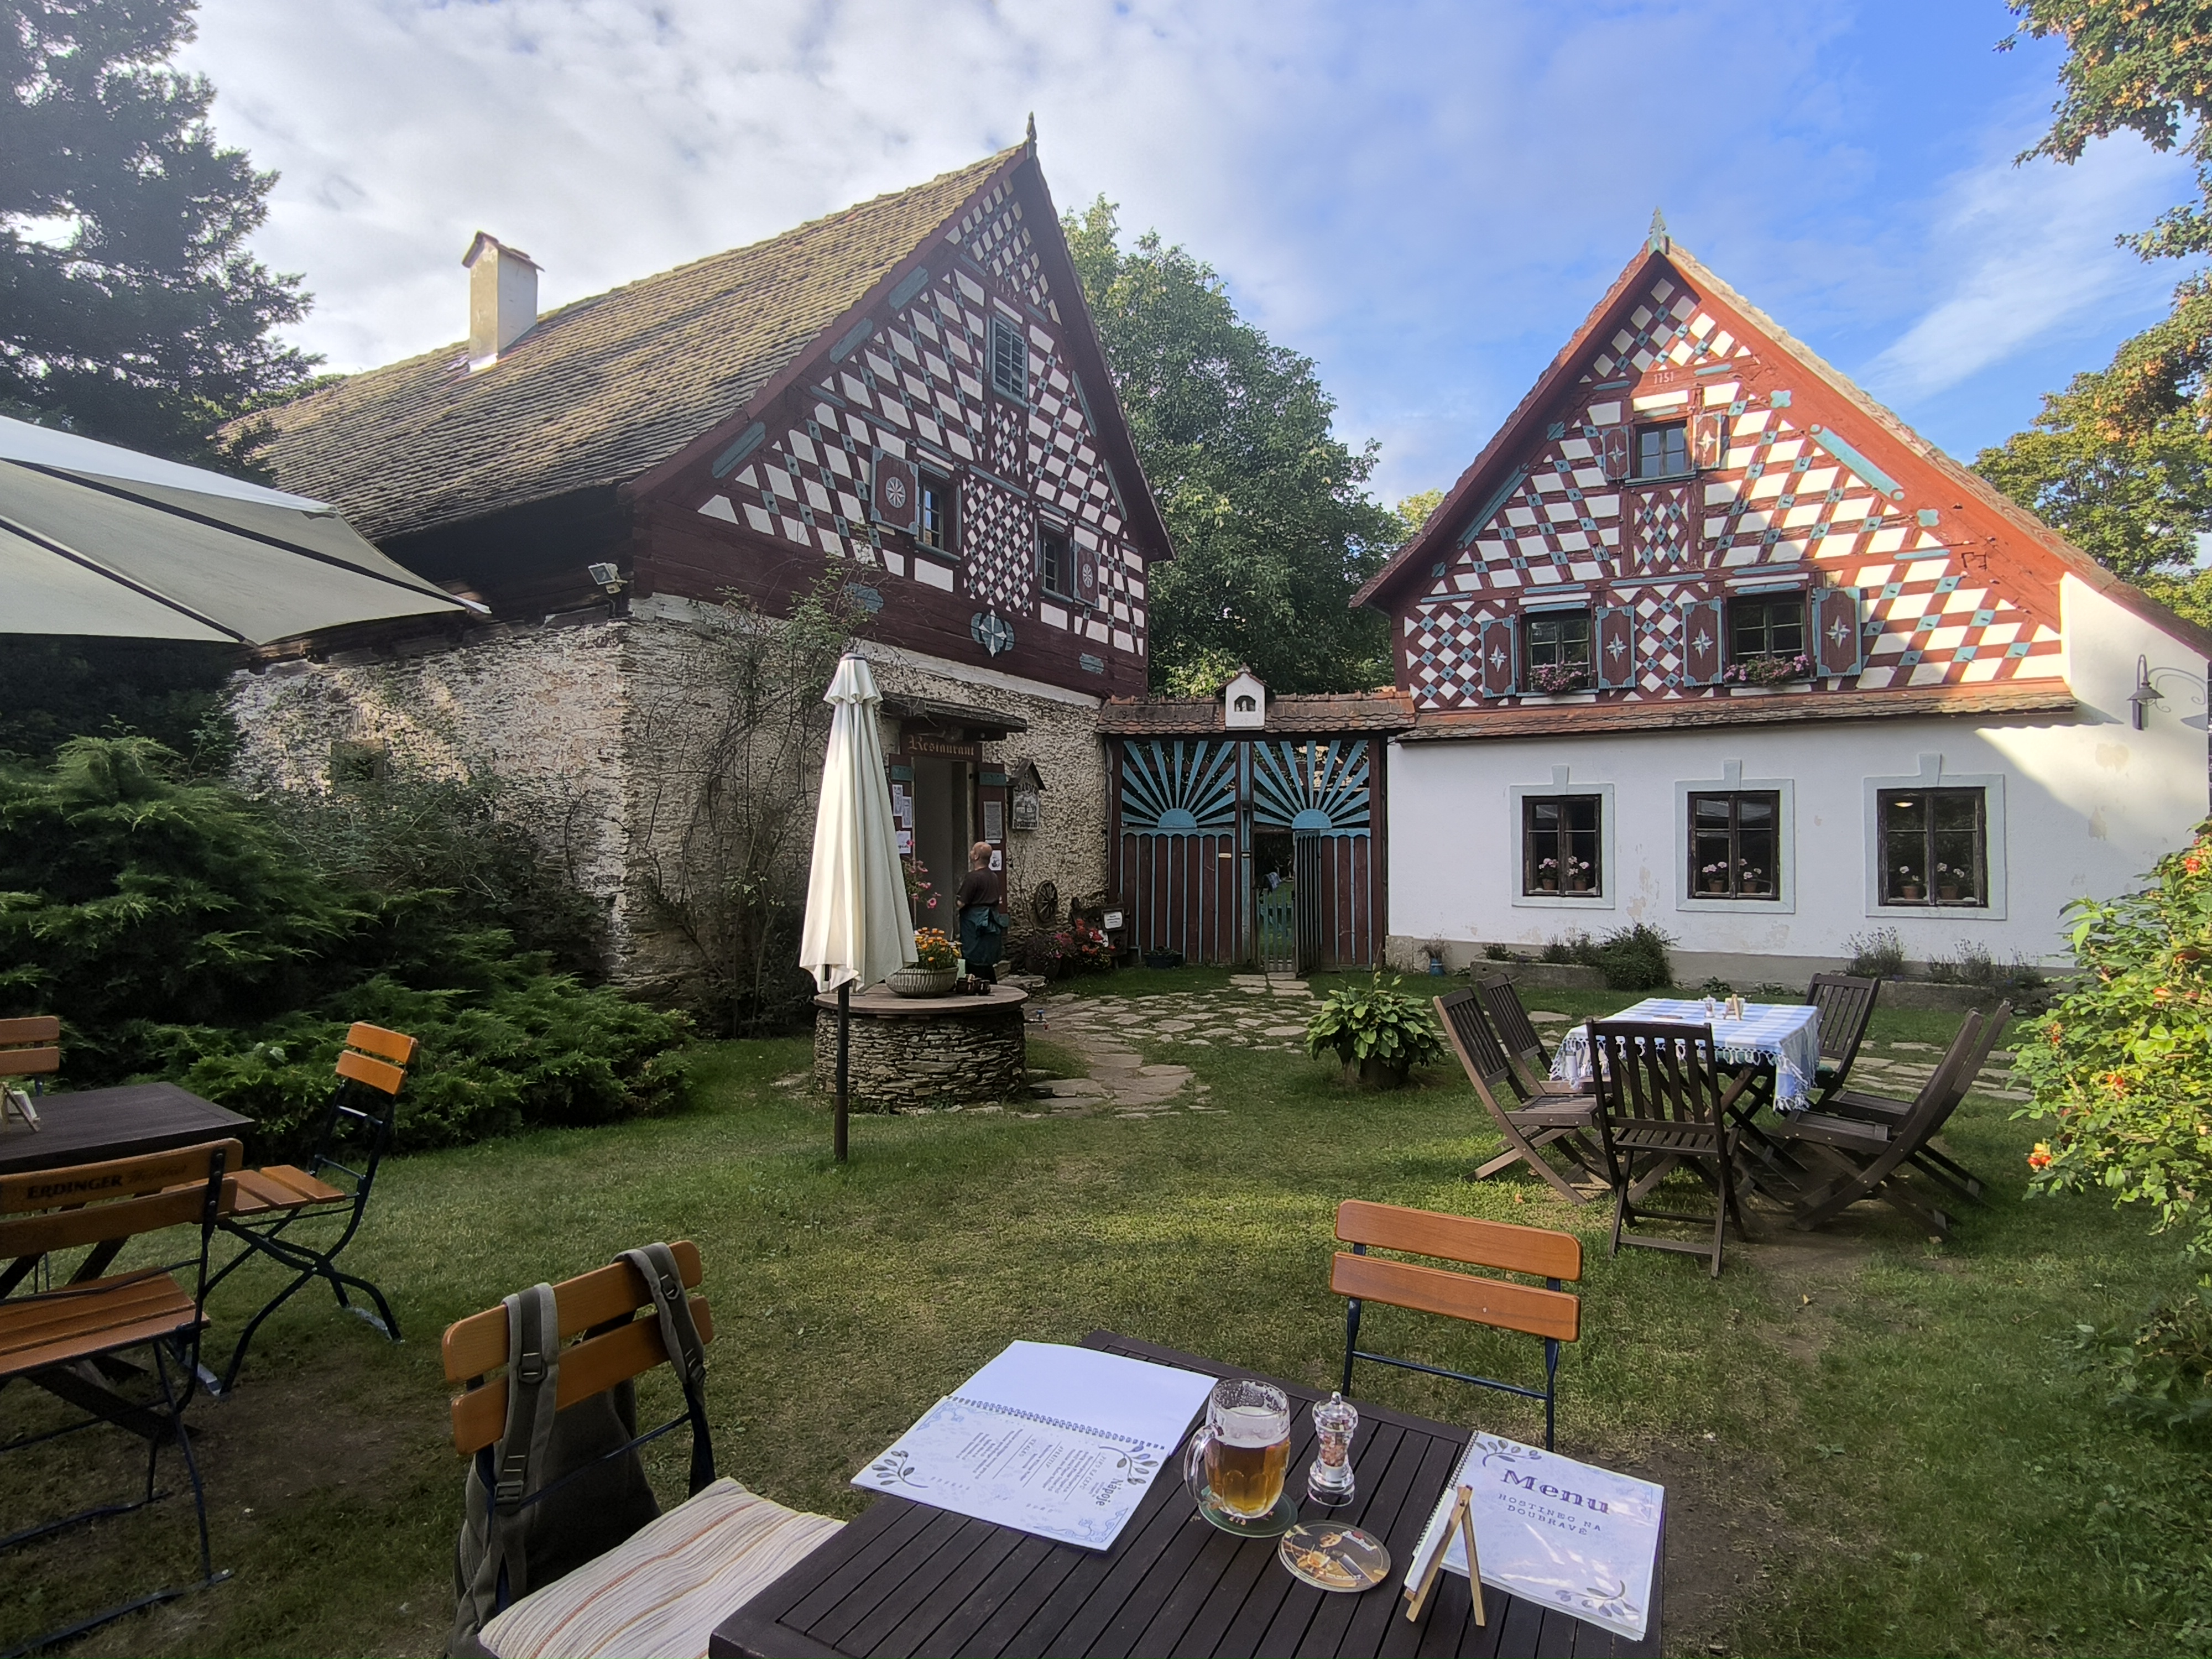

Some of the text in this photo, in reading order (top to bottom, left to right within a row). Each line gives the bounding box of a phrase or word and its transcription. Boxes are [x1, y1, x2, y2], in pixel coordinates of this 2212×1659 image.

[1653, 372, 1674, 384] 1751
[907, 734, 974, 756] Restaurant
[27, 1175, 123, 1200] ERDINGER
[1095, 1477, 1124, 1506] Nápoje
[1500, 1468, 1610, 1515] Menu
[1498, 1493, 1601, 1532] HOSTINEC NA
